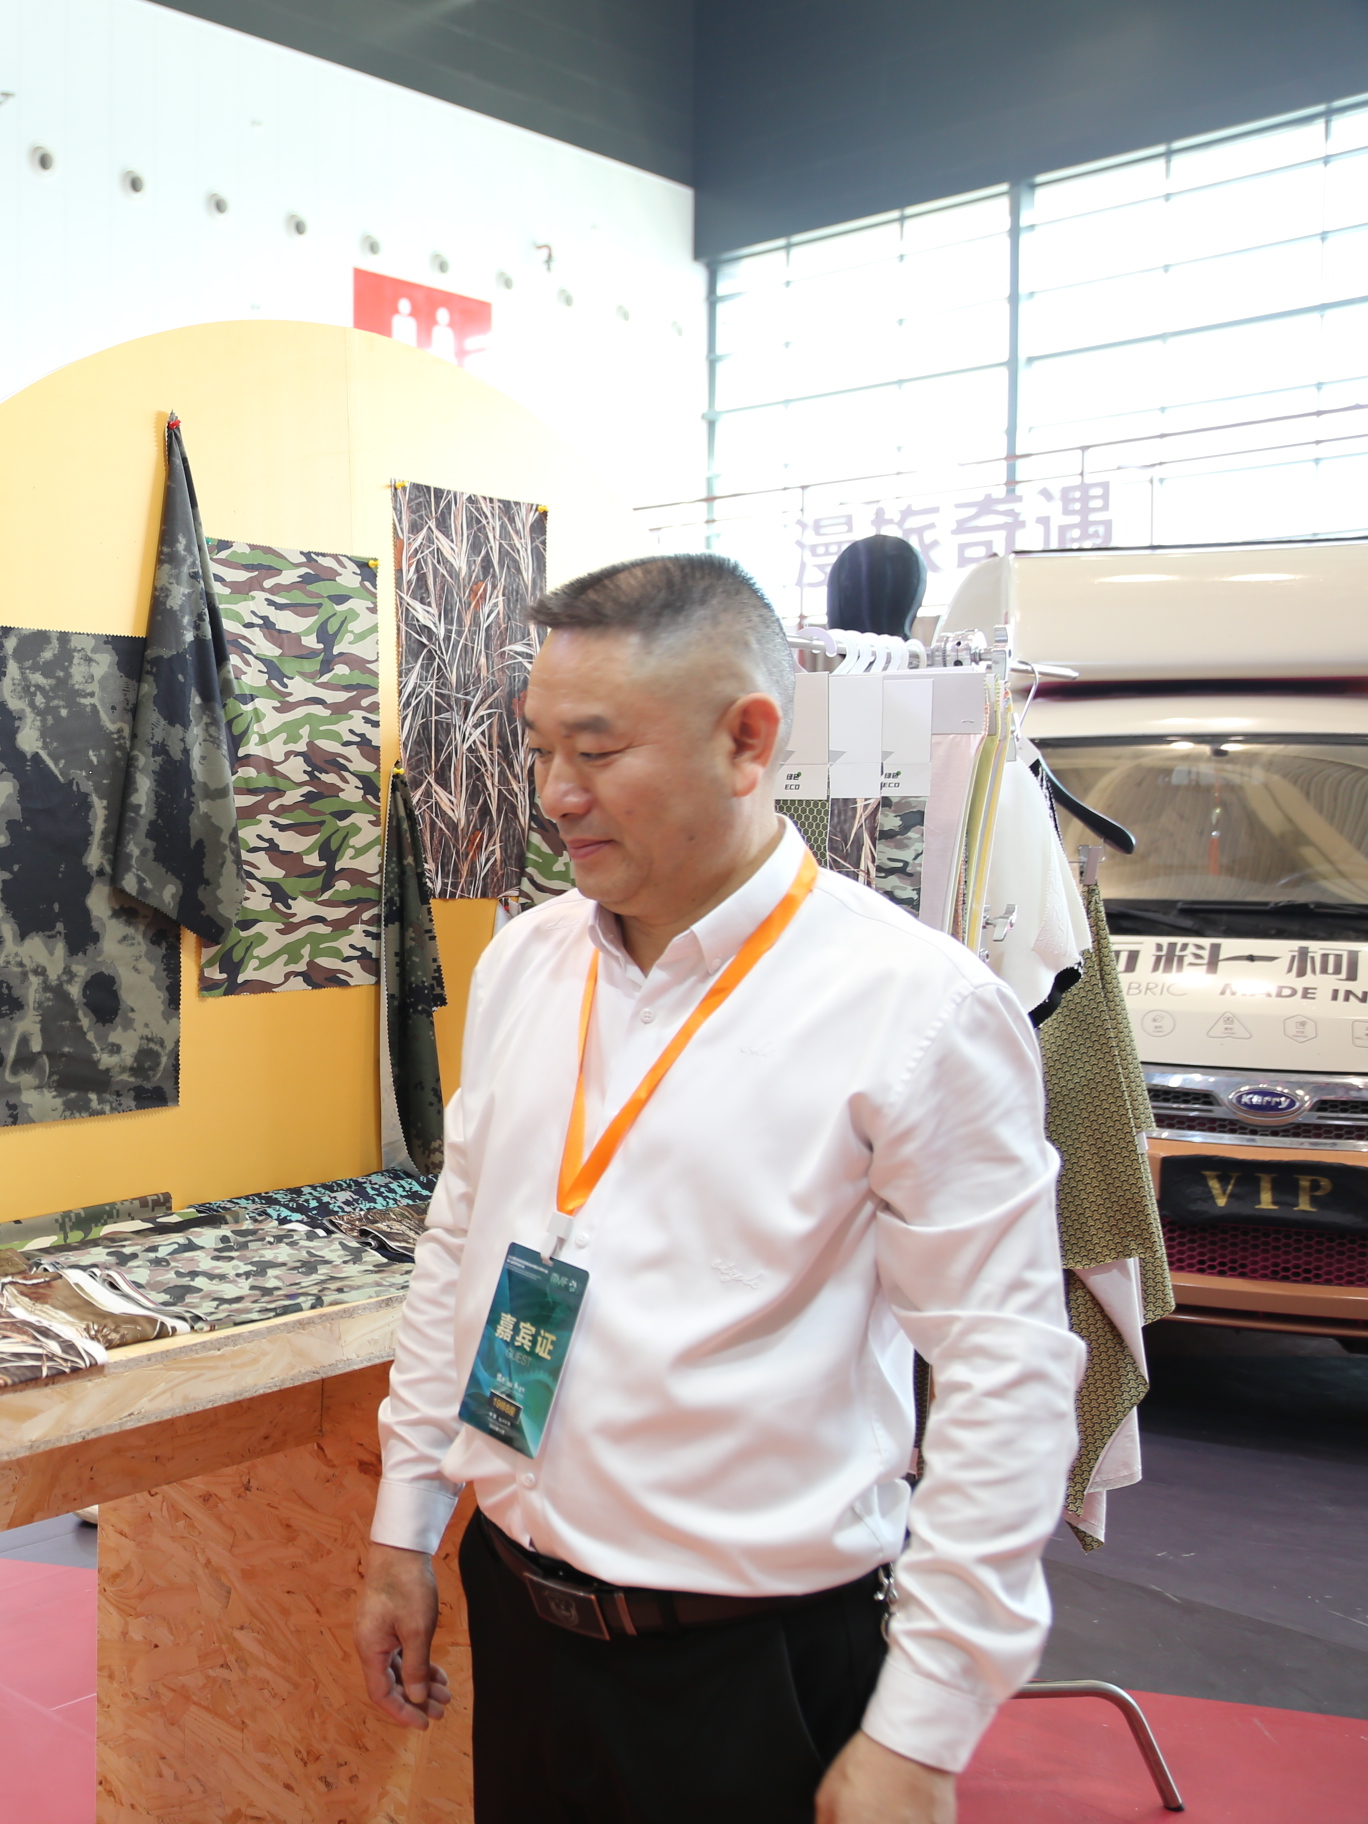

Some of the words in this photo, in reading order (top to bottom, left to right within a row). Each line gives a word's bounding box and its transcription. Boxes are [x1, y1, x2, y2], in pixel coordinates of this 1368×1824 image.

[794, 480, 1113, 588] 漫旅奇遇
[784, 783, 800, 791] ECO
[882, 781, 900, 789] ECO
[1218, 982, 1317, 1001] MADE
[1331, 988, 1368, 1004] IN
[1239, 1093, 1290, 1110] Karry
[1200, 1170, 1333, 1212] VIP
[494, 1312, 557, 1361] 嘉宾证
[505, 1348, 533, 1368] GUEST
